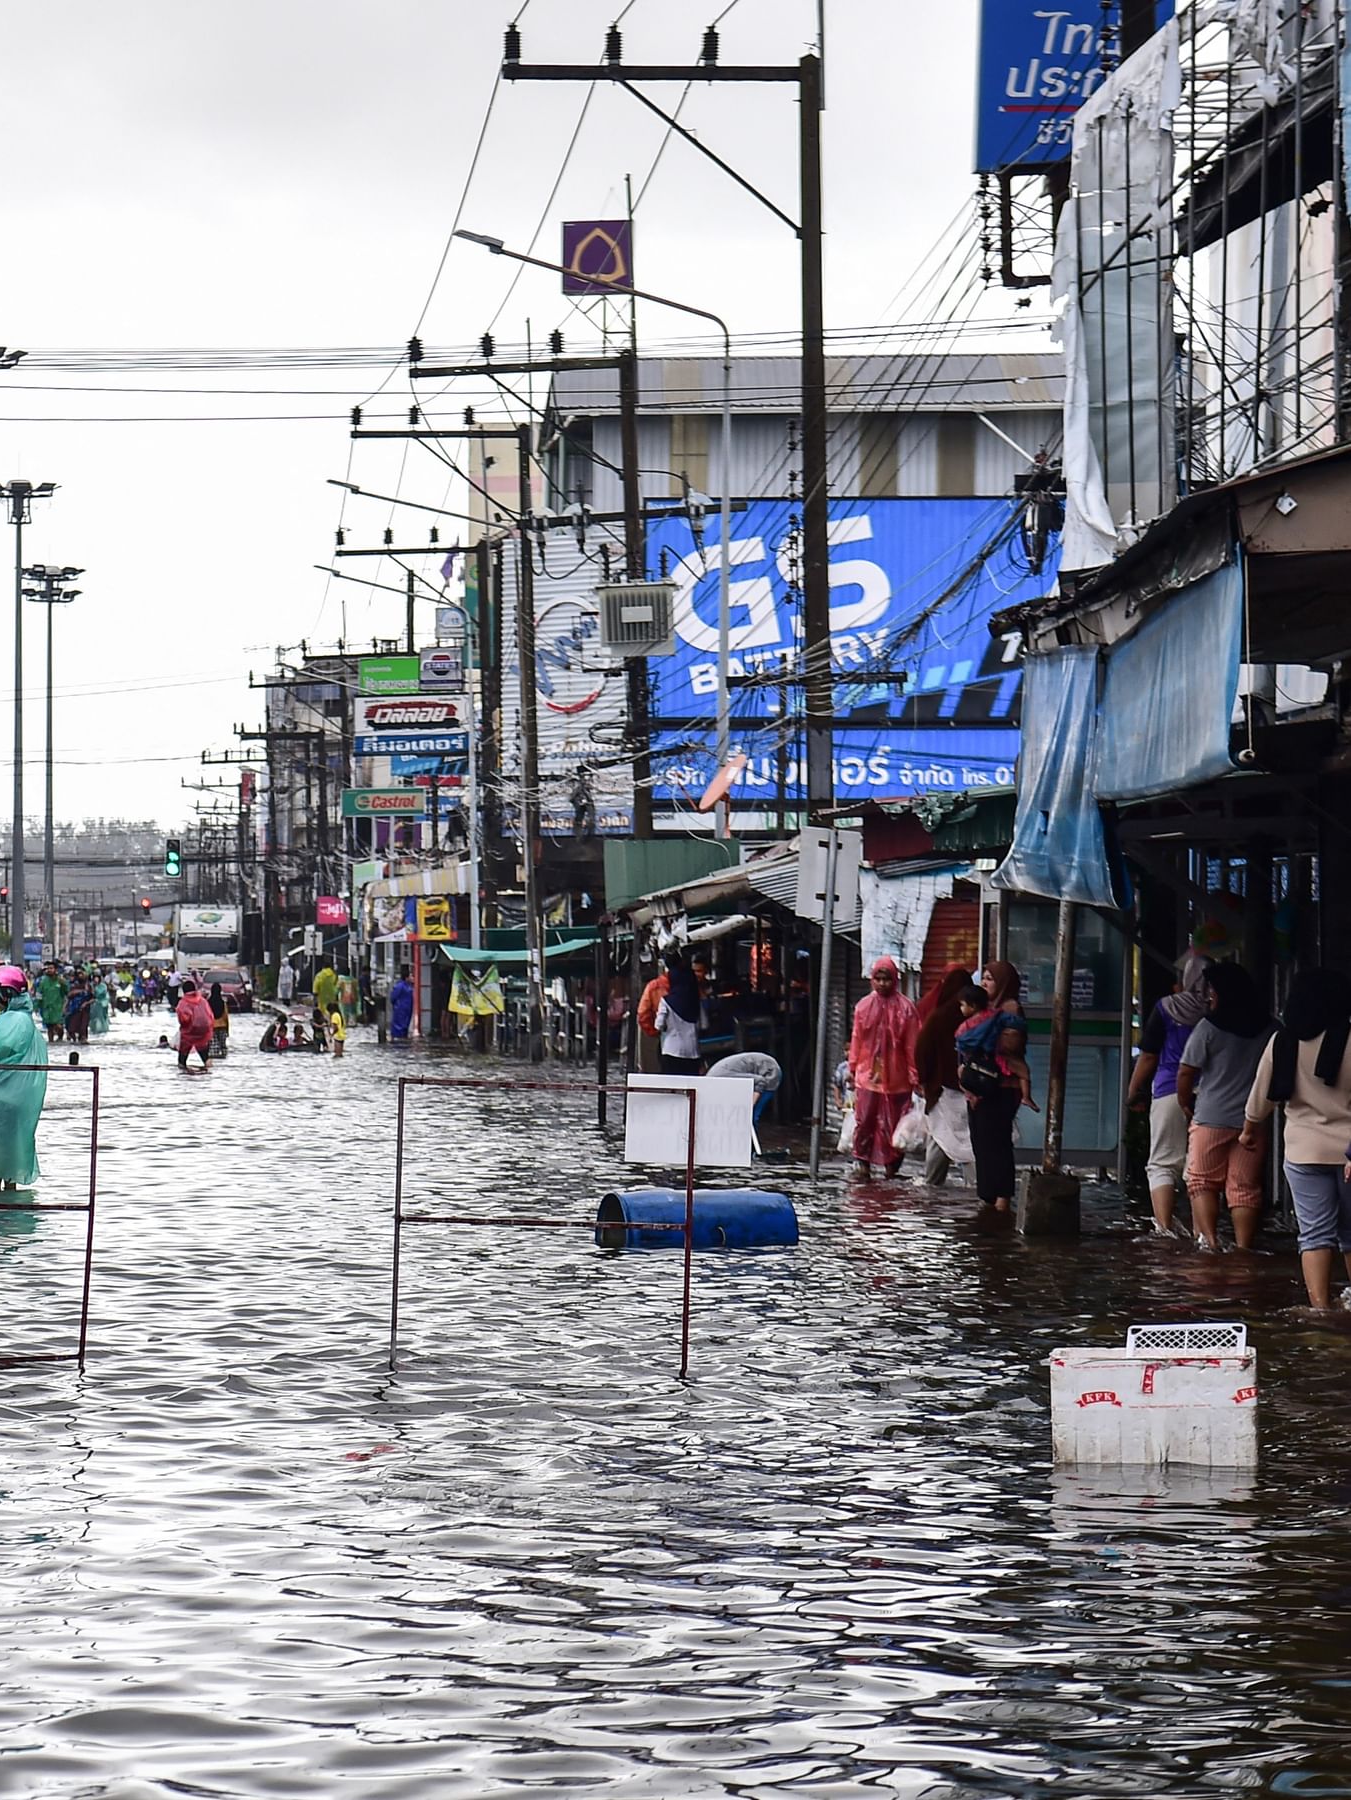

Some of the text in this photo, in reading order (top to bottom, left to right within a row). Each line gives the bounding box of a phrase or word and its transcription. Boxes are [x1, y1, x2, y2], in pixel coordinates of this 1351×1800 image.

[671, 514, 891, 653] GS
[689, 628, 891, 696] BATTRY
[899, 763, 955, 785] จำกัด
[962, 766, 992, 785] โทร.
[371, 795, 416, 809] Castrol
